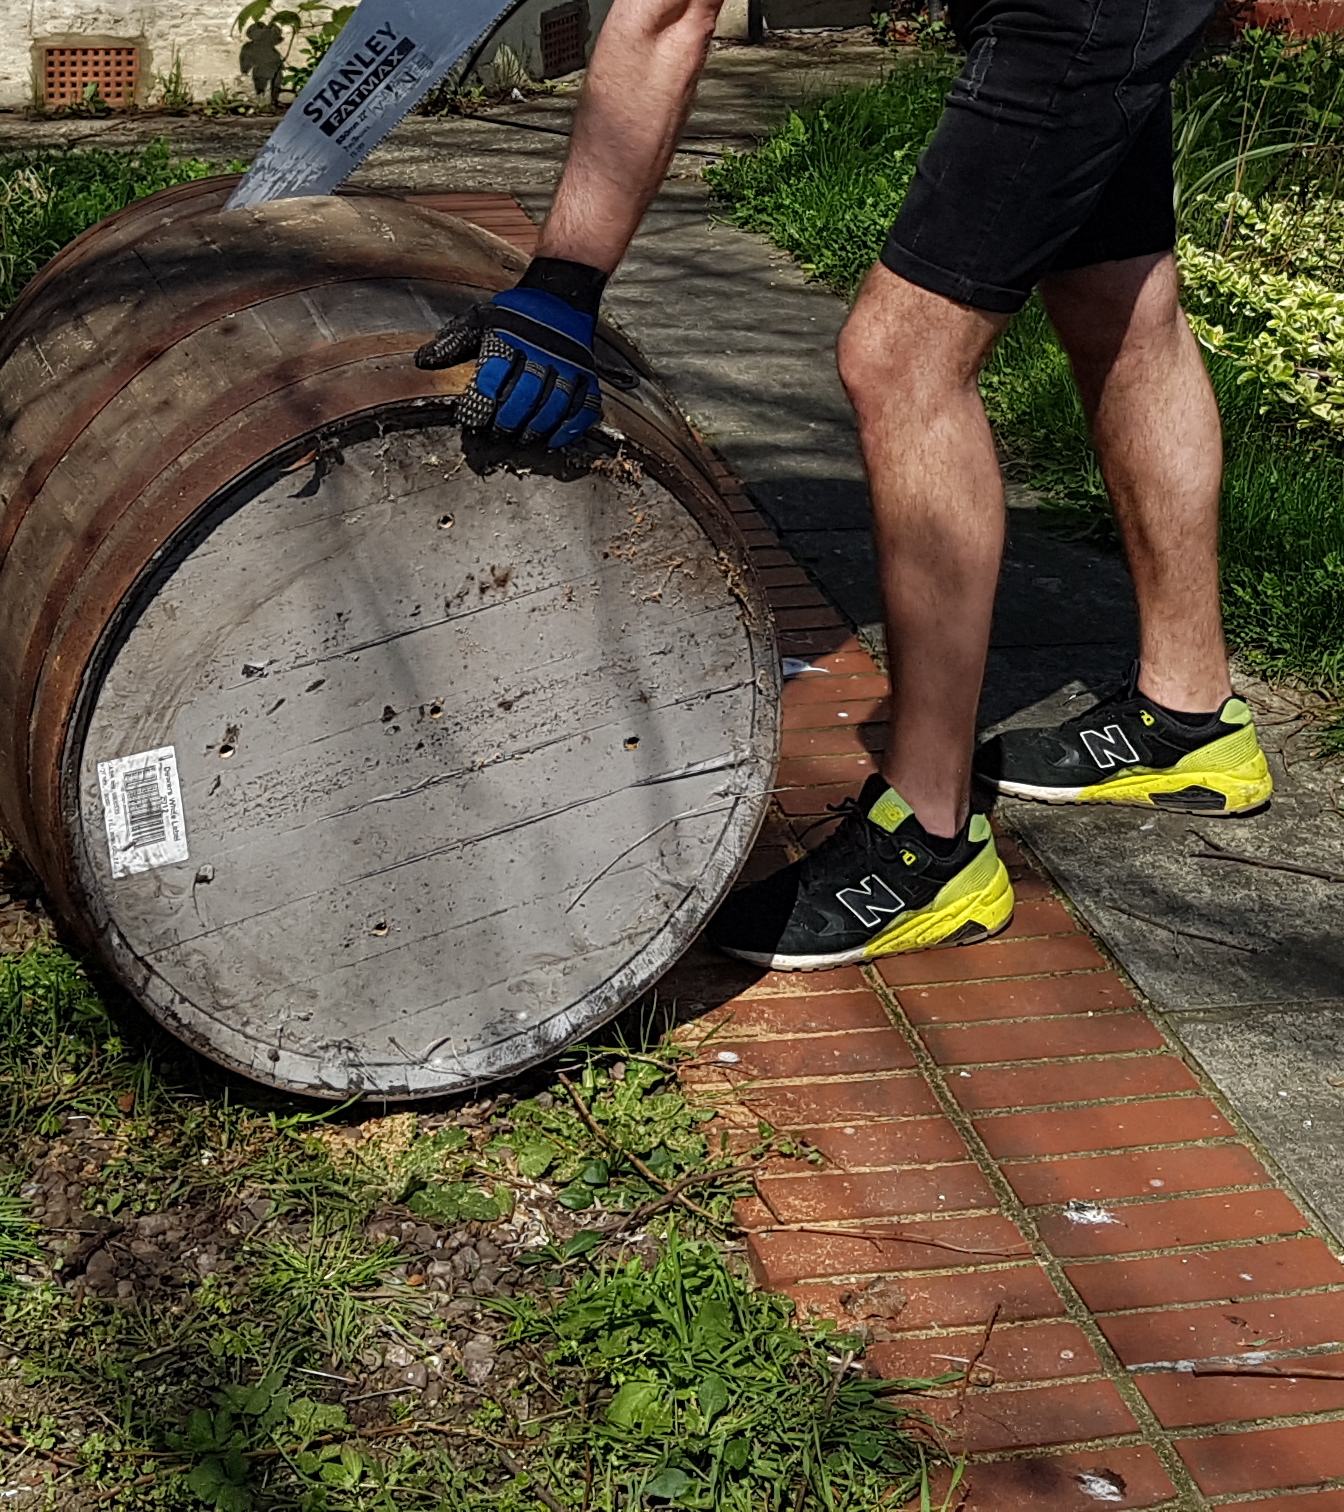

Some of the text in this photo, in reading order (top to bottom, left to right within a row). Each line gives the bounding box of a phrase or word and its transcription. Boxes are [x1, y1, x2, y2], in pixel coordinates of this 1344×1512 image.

[303, 21, 396, 123] STANLEY
[329, 49, 404, 127] FATMAX
[1081, 724, 1140, 768] N
[836, 874, 905, 927] N
